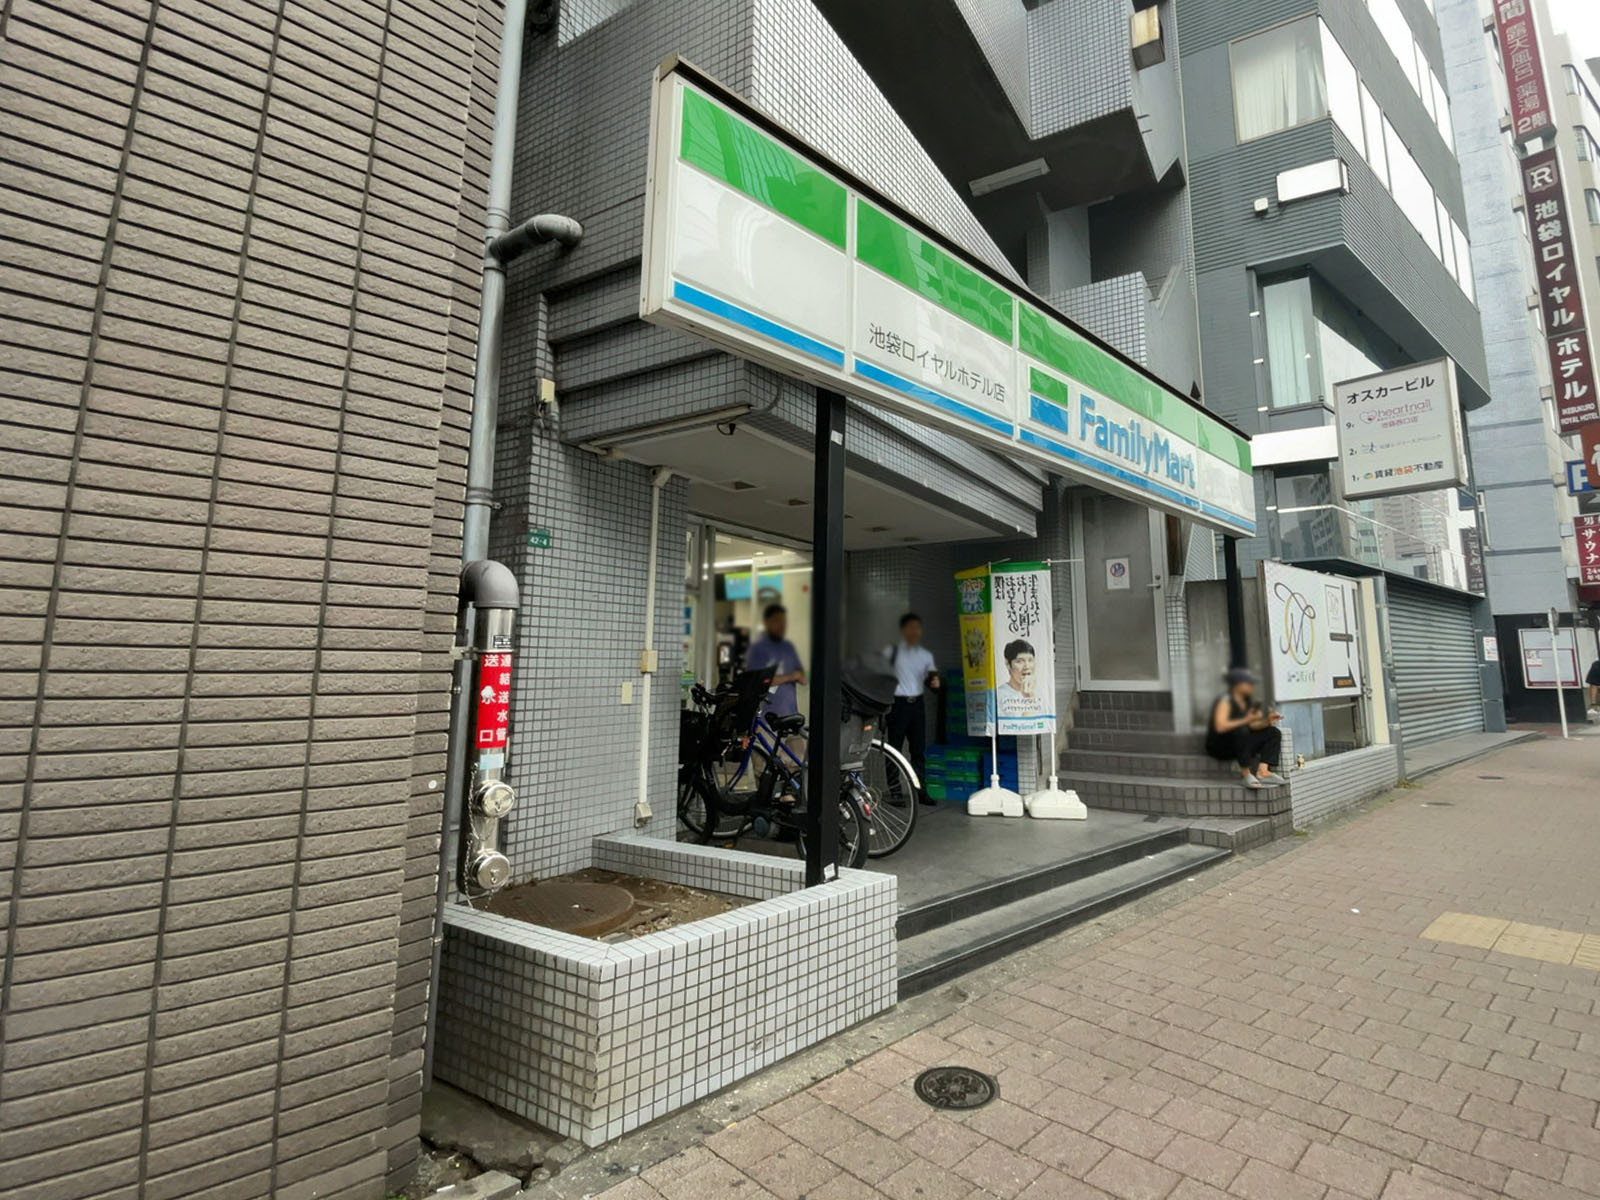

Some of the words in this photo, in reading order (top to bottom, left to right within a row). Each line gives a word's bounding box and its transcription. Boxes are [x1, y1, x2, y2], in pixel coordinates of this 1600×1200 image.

[1505, 21, 1536, 82] 露天風呂
[1517, 110, 1548, 135] 2階
[1530, 167, 1554, 190] R
[1534, 200, 1588, 400] 池袋ロイヤルホテル
[869, 323, 1006, 403] 池袋ロイヤルホテル店
[1347, 376, 1435, 405] オスカービル
[1079, 393, 1196, 489] FamilyMart
[1581, 528, 1600, 565] サウナ
